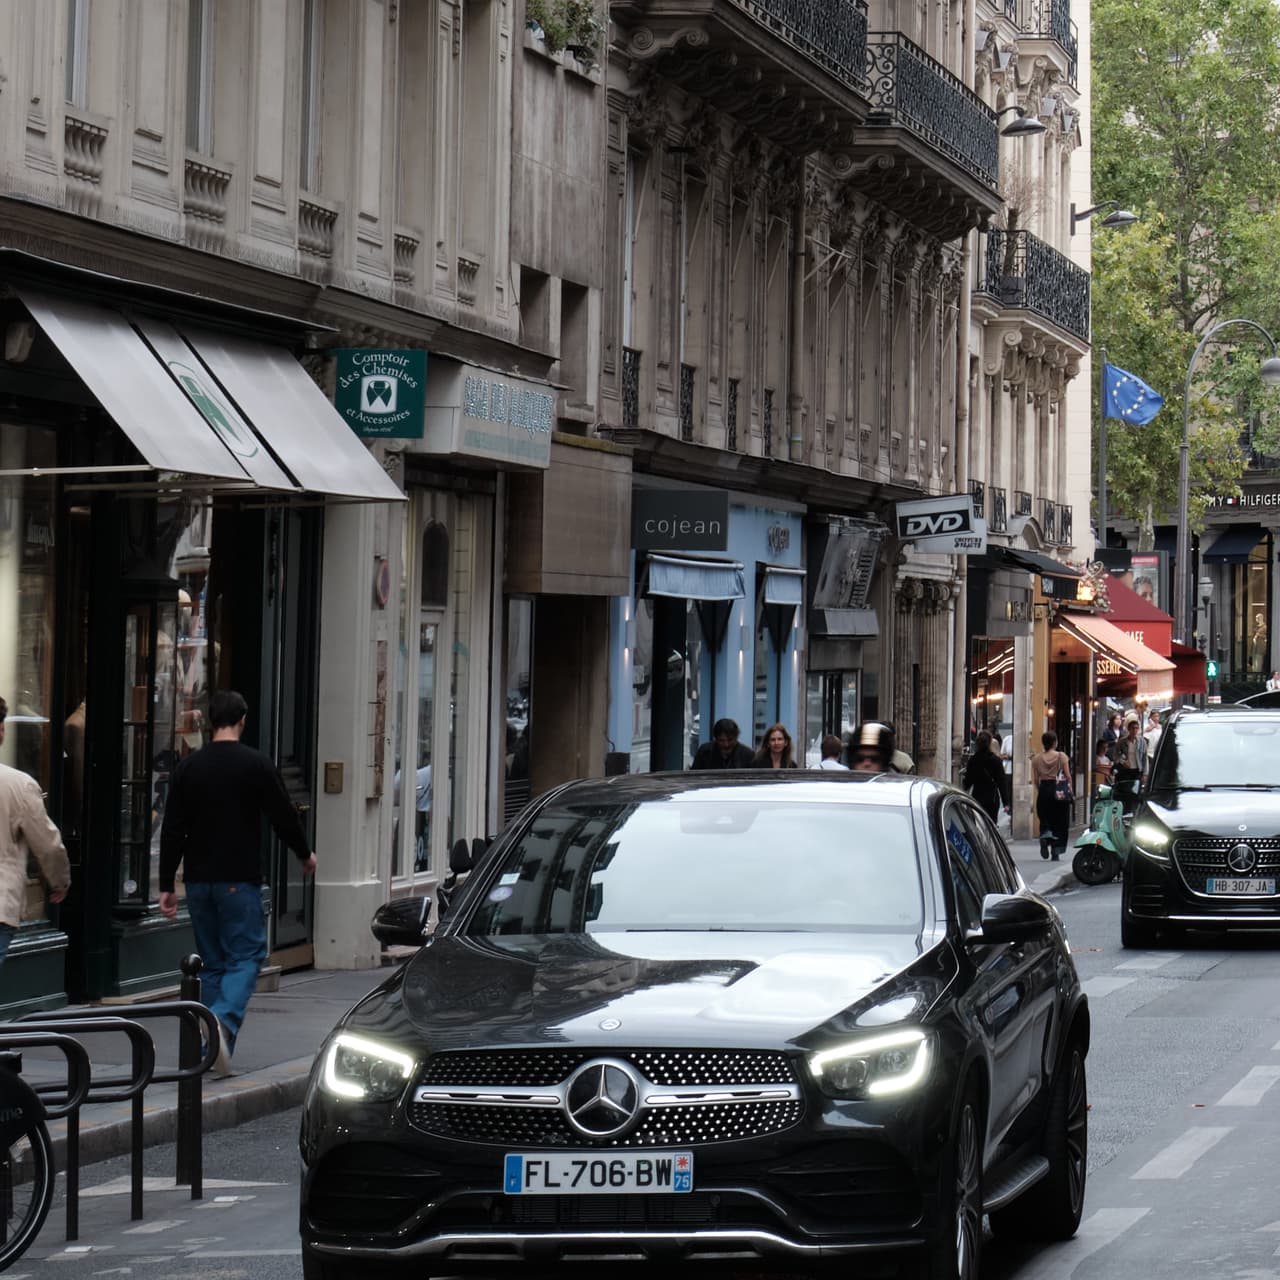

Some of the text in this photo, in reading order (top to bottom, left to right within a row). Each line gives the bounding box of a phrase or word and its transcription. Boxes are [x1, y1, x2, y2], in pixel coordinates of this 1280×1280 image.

[352, 352, 410, 367] Comptoir
[339, 362, 418, 388] des Chemises
[355, 409, 410, 424] Accessoires
[645, 515, 721, 538] cojean
[906, 513, 964, 536] DVD
[675, 1175, 690, 1189] 75
